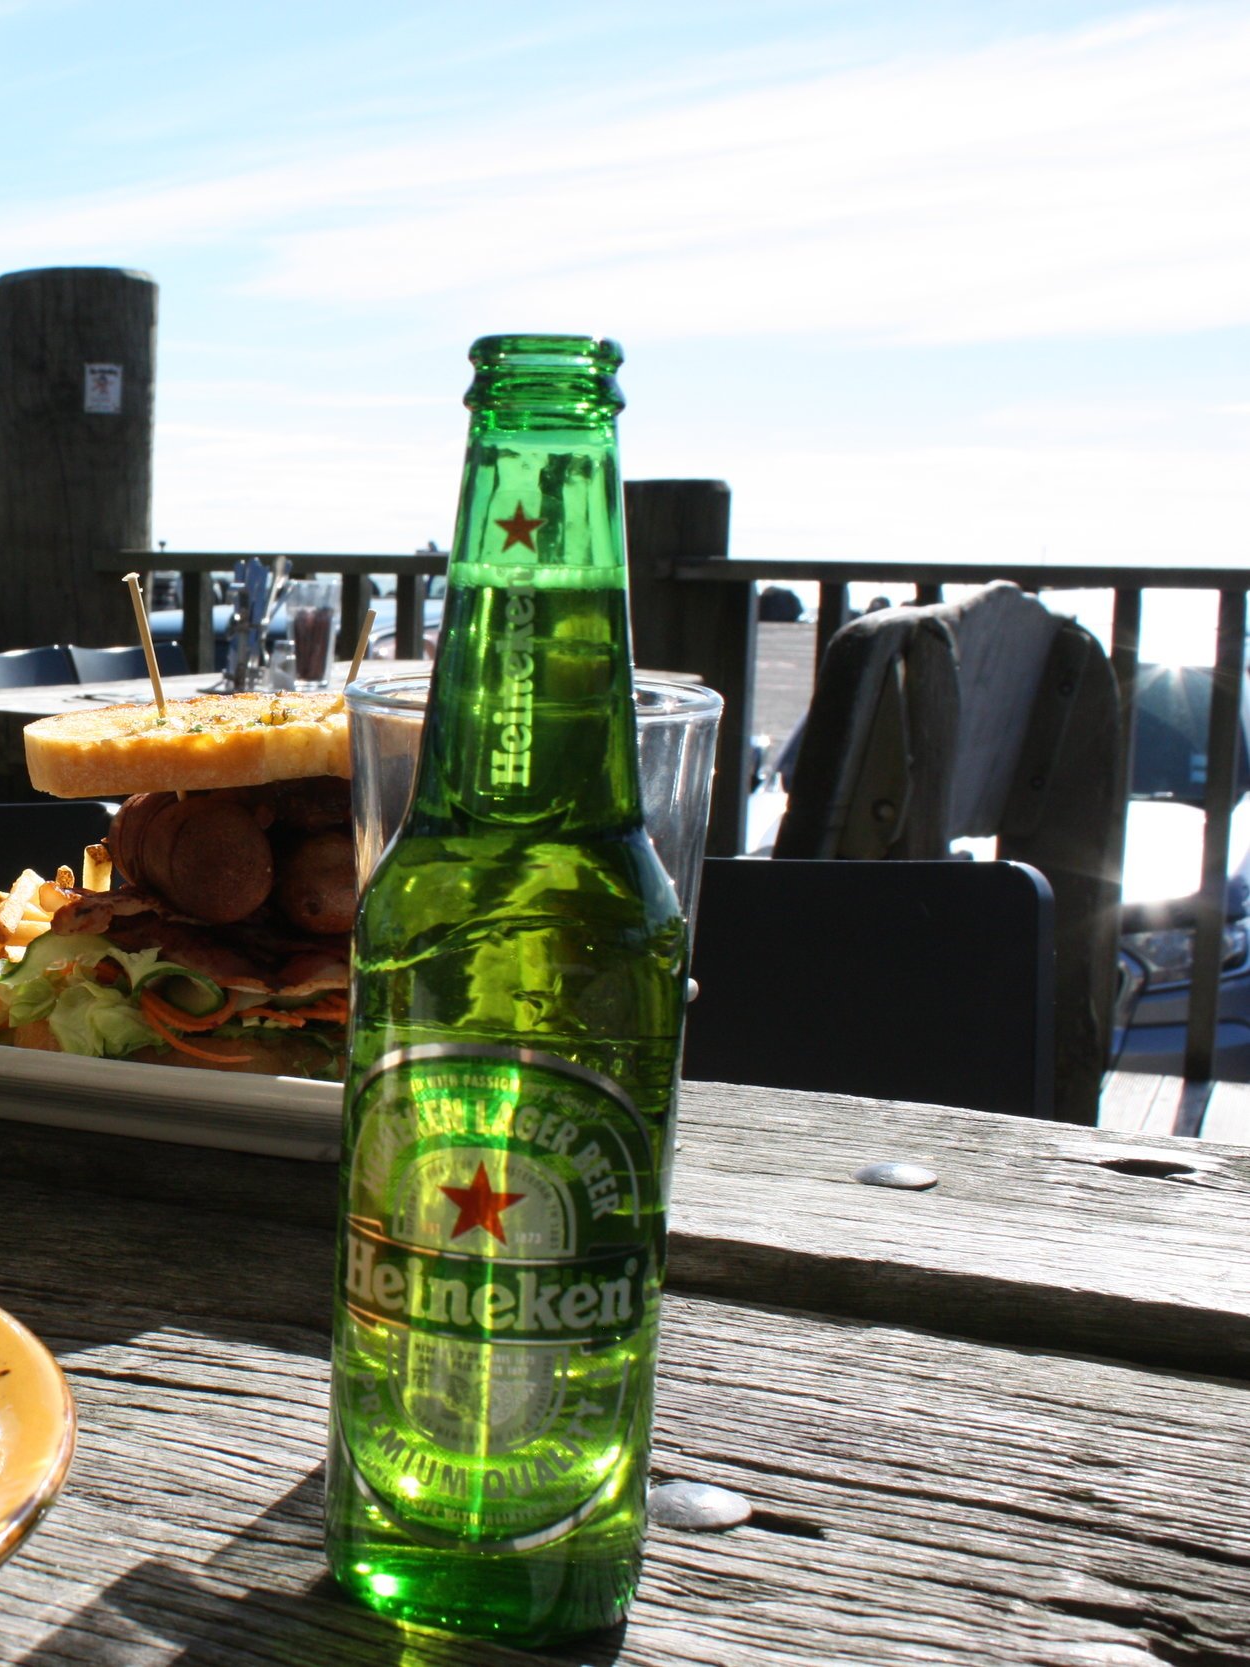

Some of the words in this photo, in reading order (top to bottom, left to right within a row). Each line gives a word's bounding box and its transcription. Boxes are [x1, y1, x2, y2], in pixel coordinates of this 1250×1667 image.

[491, 568, 535, 787] Heineken
[473, 1100, 577, 1157] LAGER
[571, 1140, 621, 1221] BEER
[345, 1233, 635, 1331] Heineken
